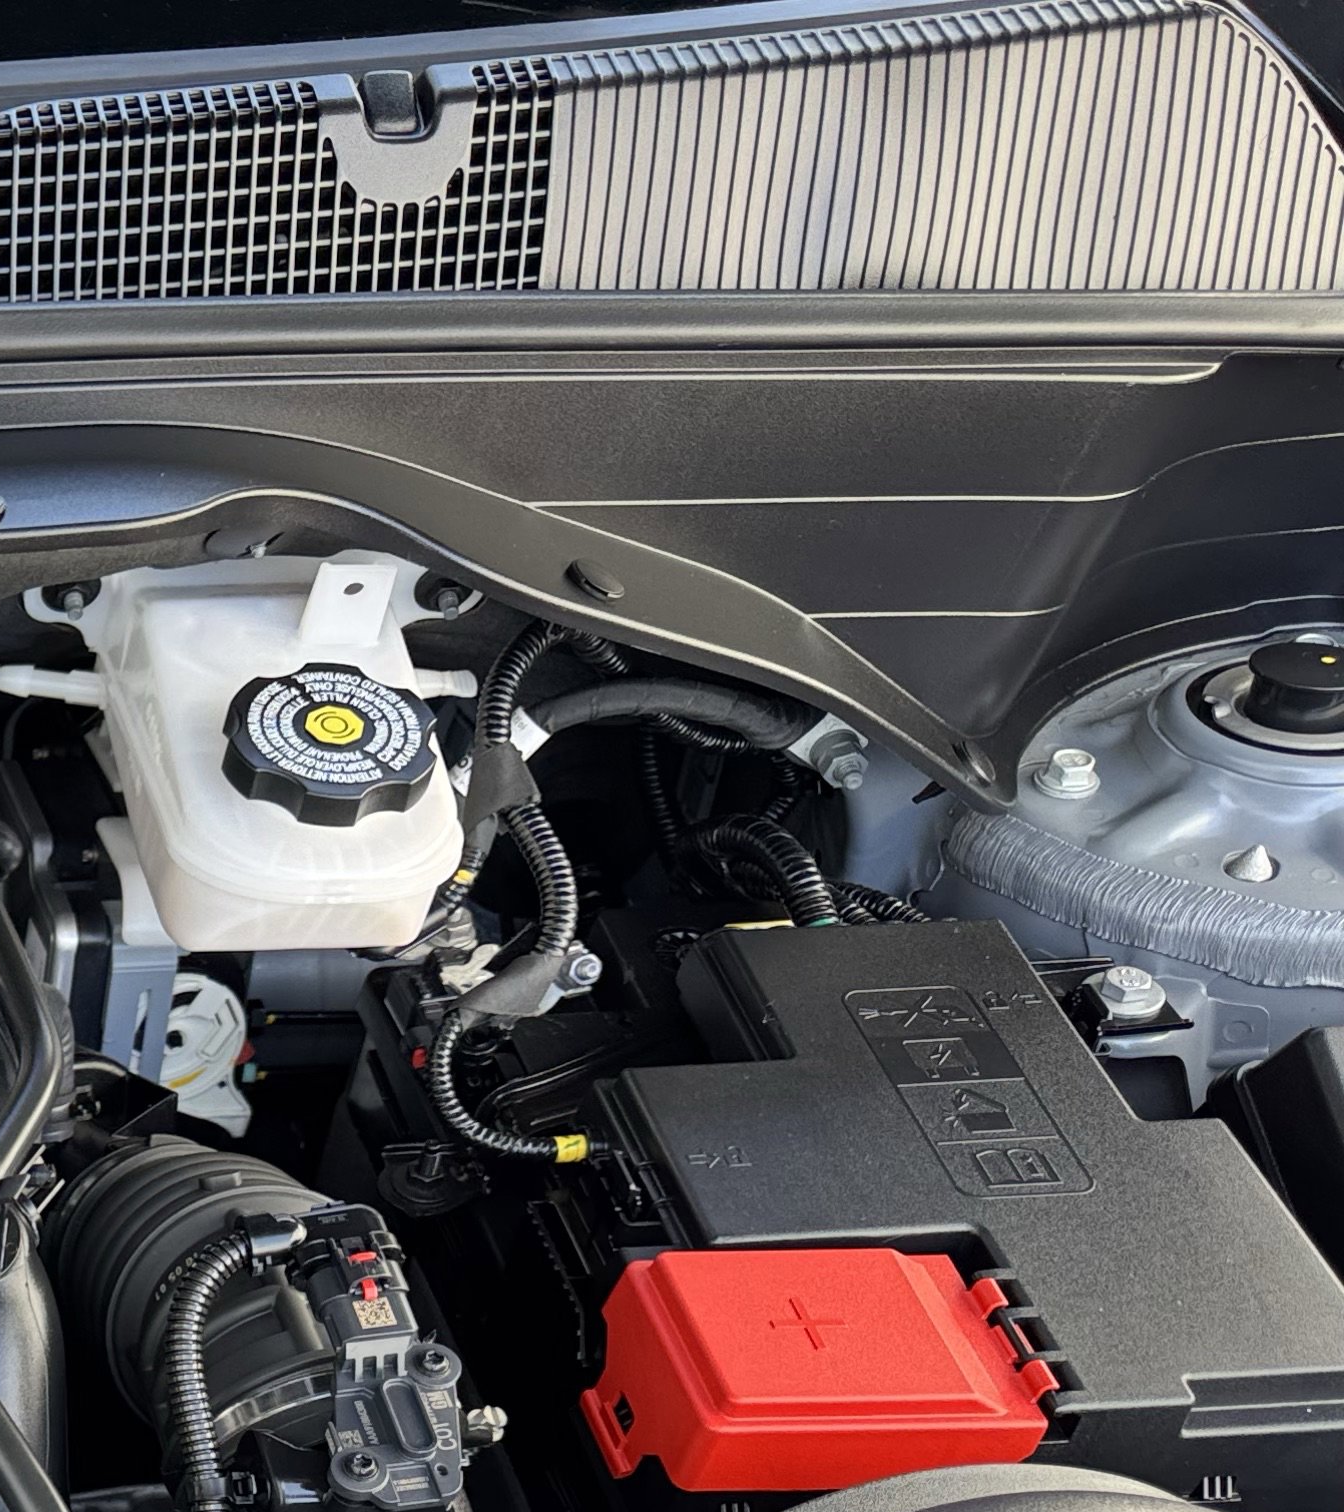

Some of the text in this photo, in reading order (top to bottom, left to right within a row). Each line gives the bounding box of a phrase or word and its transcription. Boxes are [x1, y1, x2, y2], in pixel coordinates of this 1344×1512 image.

[304, 682, 333, 694] ONLY
[359, 677, 404, 705] SEALED
[310, 692, 384, 720] CLEAN FILLER
[264, 749, 285, 763] LE
